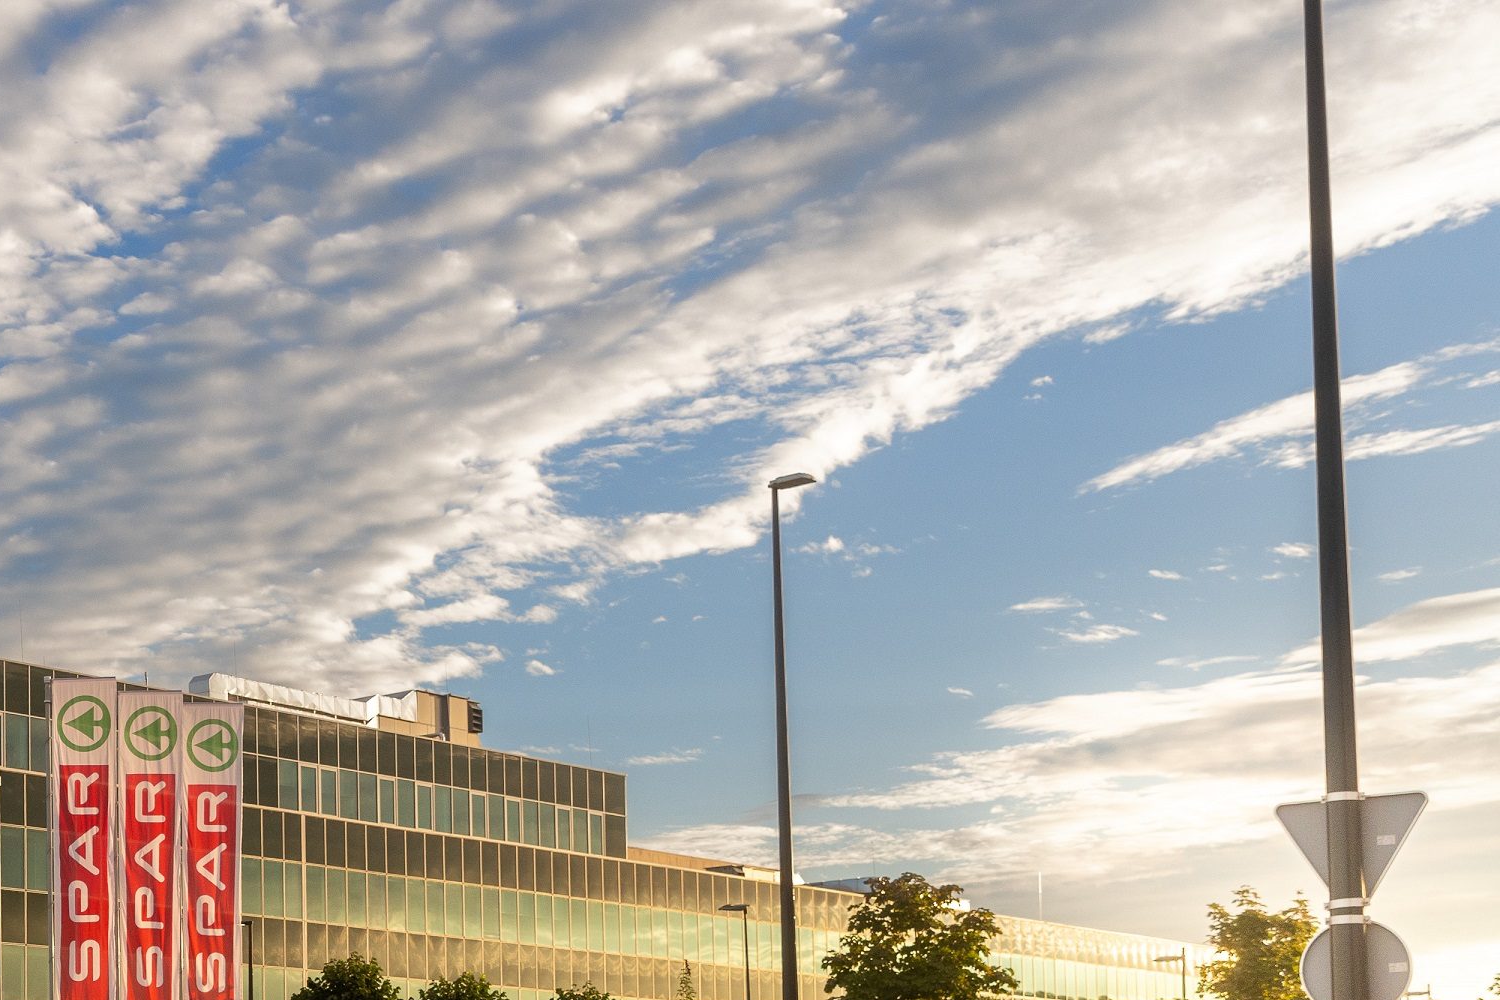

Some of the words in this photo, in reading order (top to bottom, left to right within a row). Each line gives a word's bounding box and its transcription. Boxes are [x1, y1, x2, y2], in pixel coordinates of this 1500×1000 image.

[67, 771, 100, 982] SPAR
[134, 780, 166, 988] SPAR
[195, 790, 228, 993] SPAR
